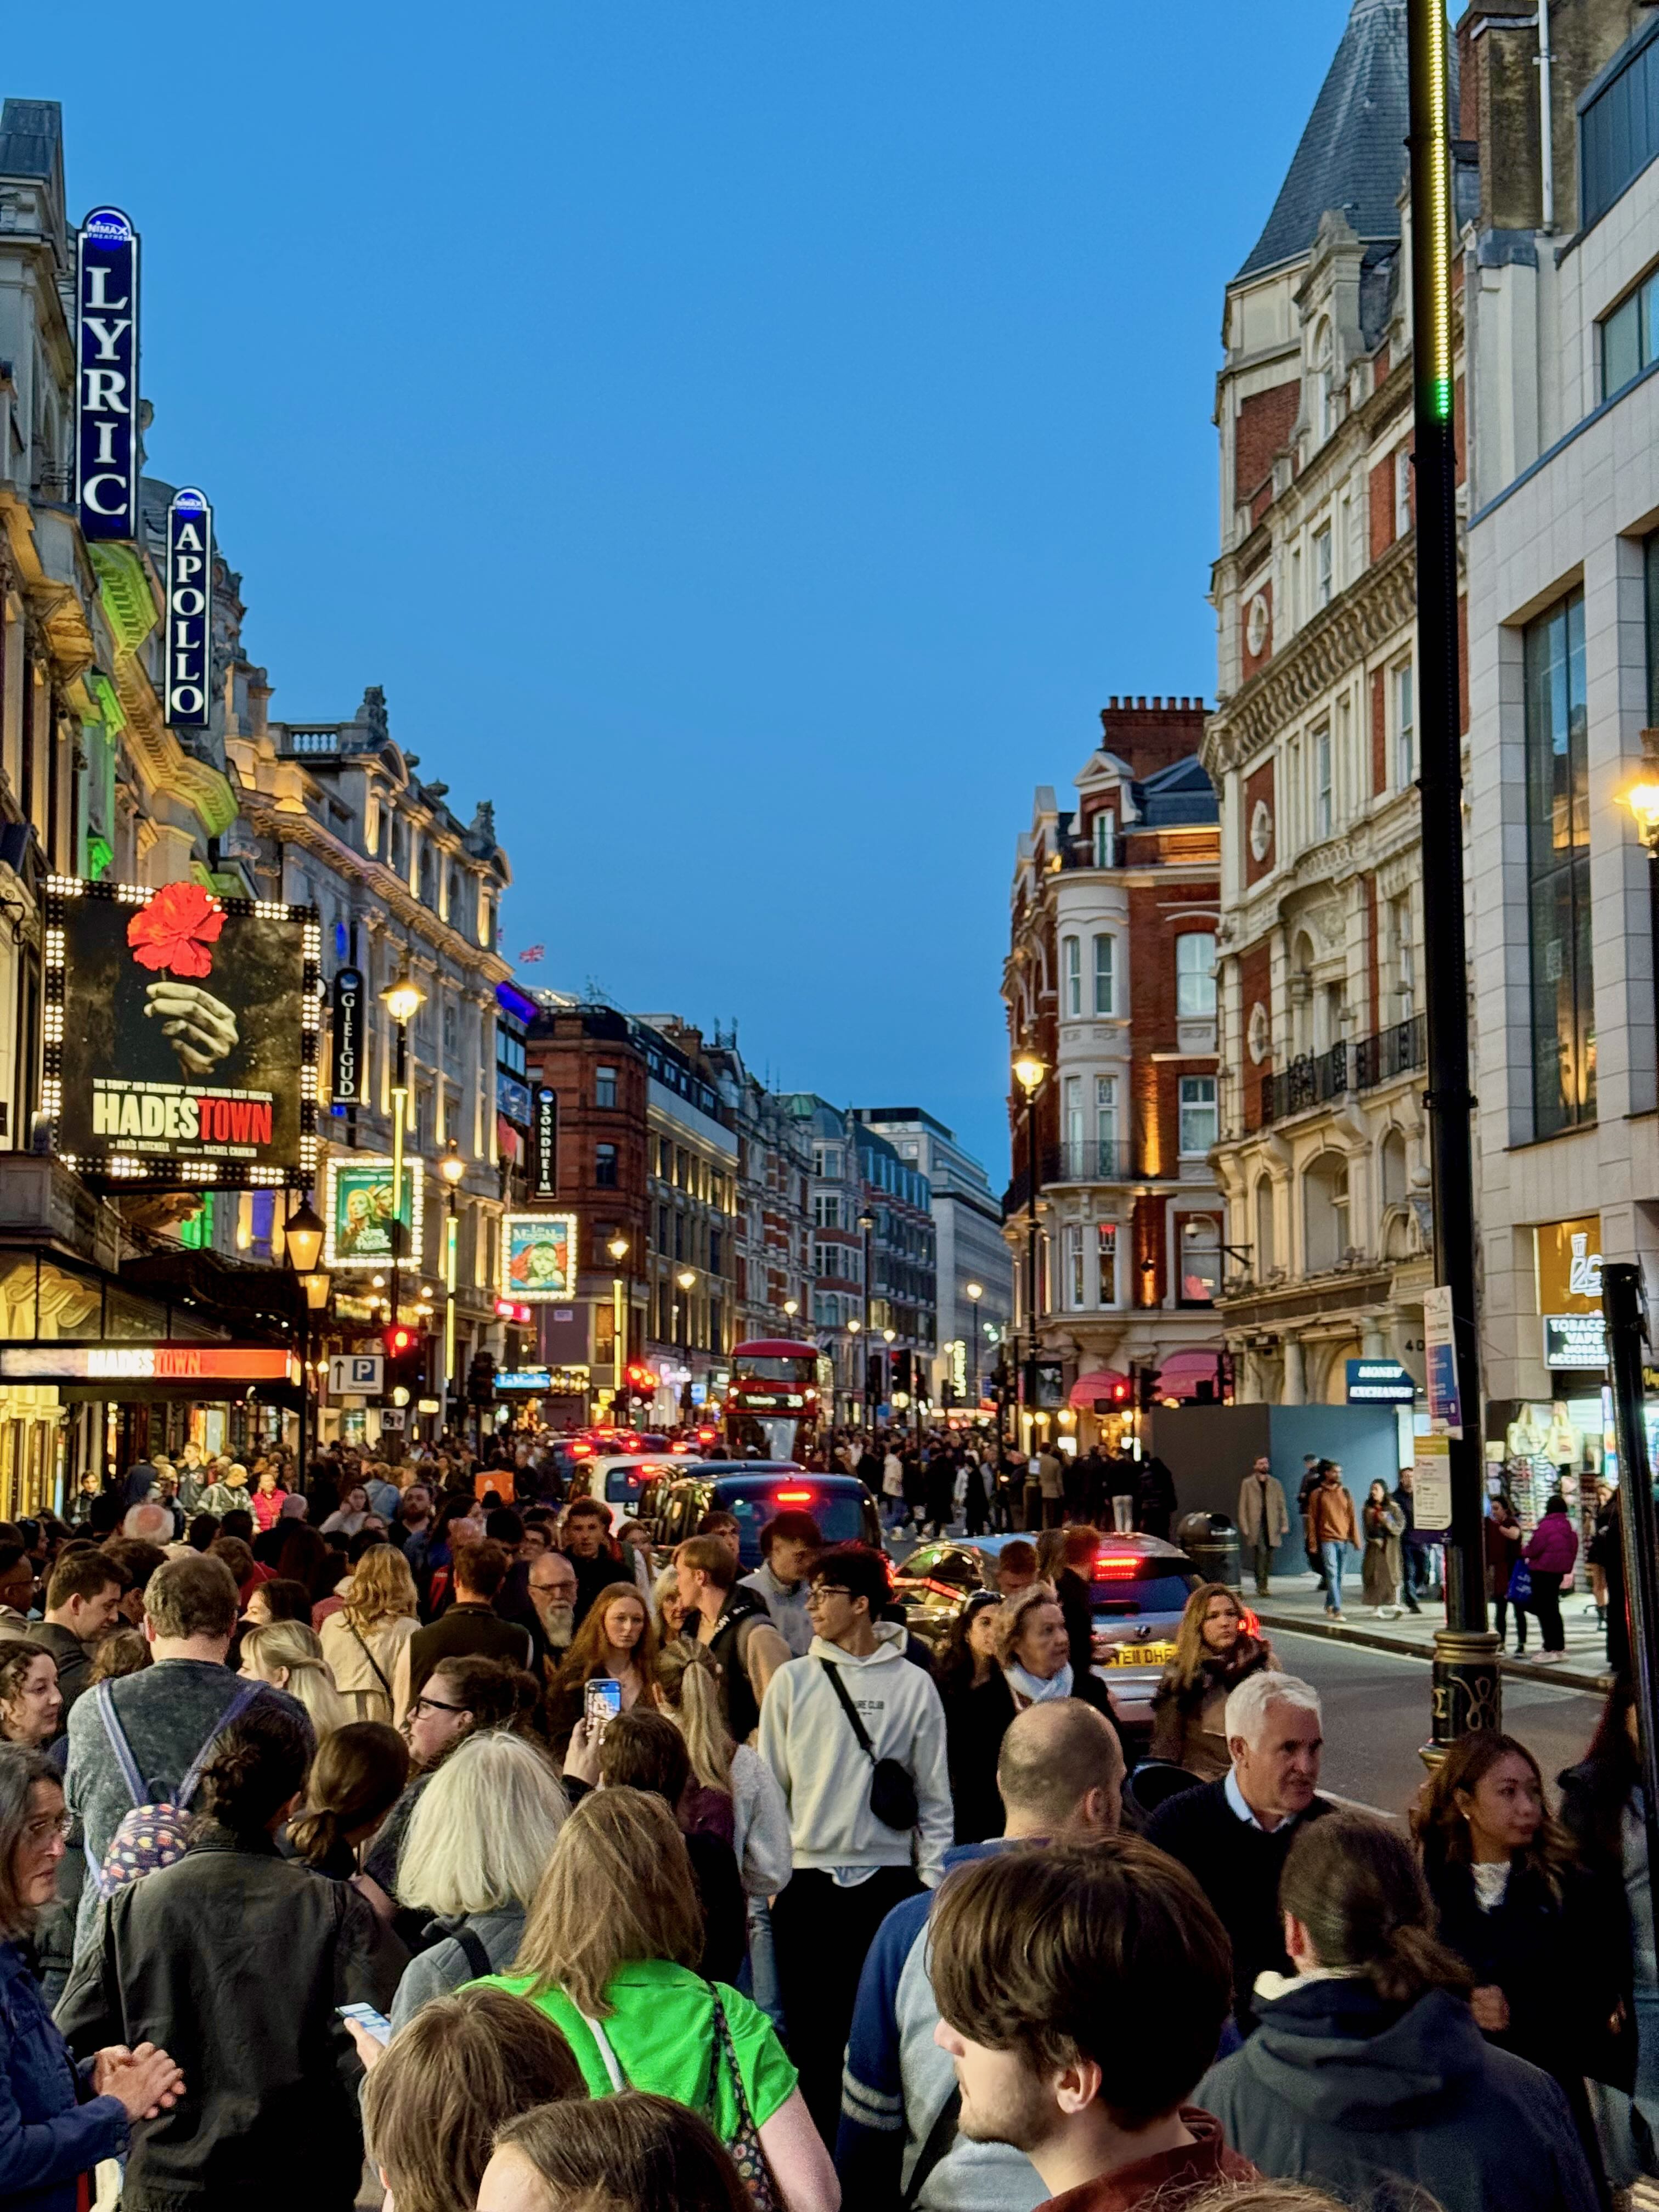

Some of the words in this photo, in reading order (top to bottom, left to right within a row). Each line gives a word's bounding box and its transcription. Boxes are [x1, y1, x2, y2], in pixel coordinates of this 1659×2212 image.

[82, 267, 132, 517] LYRIC
[171, 522, 205, 715] APOLLO
[340, 992, 356, 1096] GIELGUD
[93, 1092, 273, 1145] HADESTOWN
[539, 1104, 552, 1191] SONDHEIM
[1550, 1319, 1606, 1333] TOBACC
[1565, 1332, 1604, 1345] VAPE
[87, 1349, 201, 1377] HADESTOWN
[1358, 1366, 1405, 1378] MONEY
[787, 1395, 803, 1407] 38
[1350, 1386, 1414, 1398] EXCHANGE
[868, 1701, 884, 1709] CLUB
